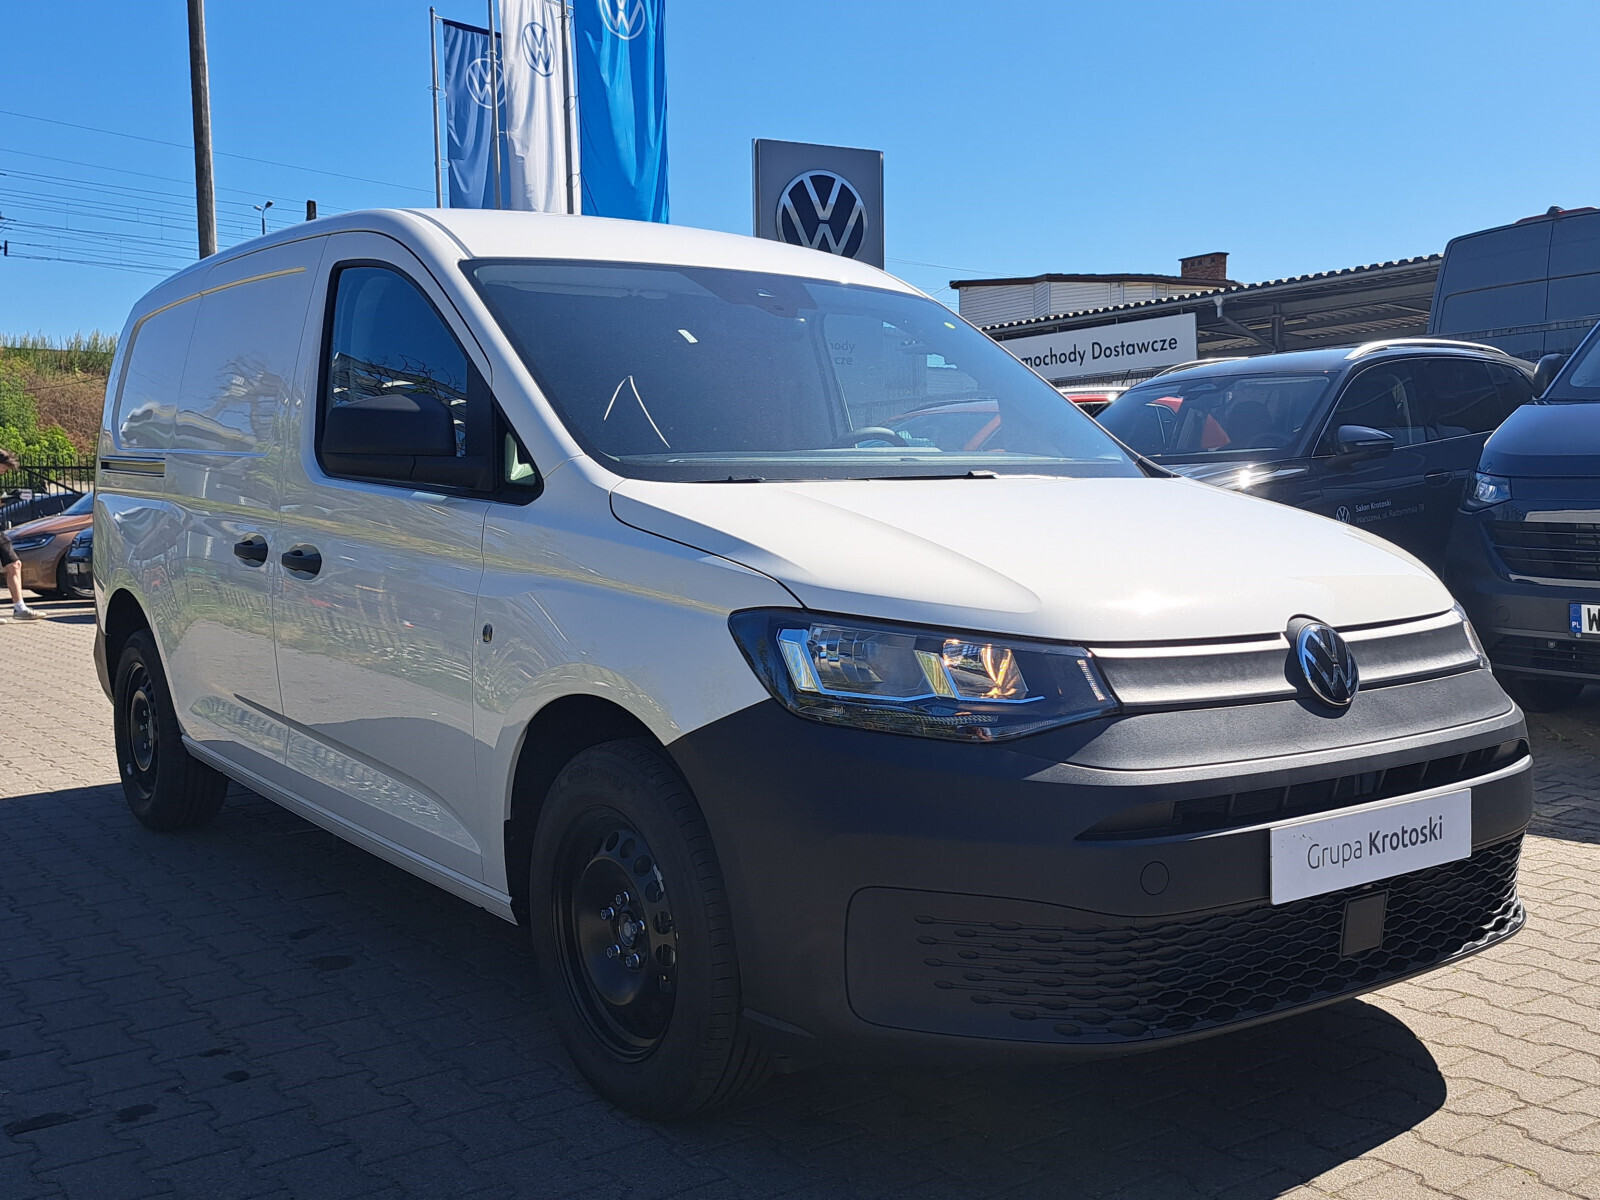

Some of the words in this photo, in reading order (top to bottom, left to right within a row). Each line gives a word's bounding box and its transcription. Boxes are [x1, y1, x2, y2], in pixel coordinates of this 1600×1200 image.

[1091, 337, 1178, 360] Dostawcze
[1370, 498, 1392, 510] Krotoski
[1571, 621, 1581, 629] PL
[1307, 840, 1363, 870] Grupa
[1368, 815, 1443, 857] Krotoski
